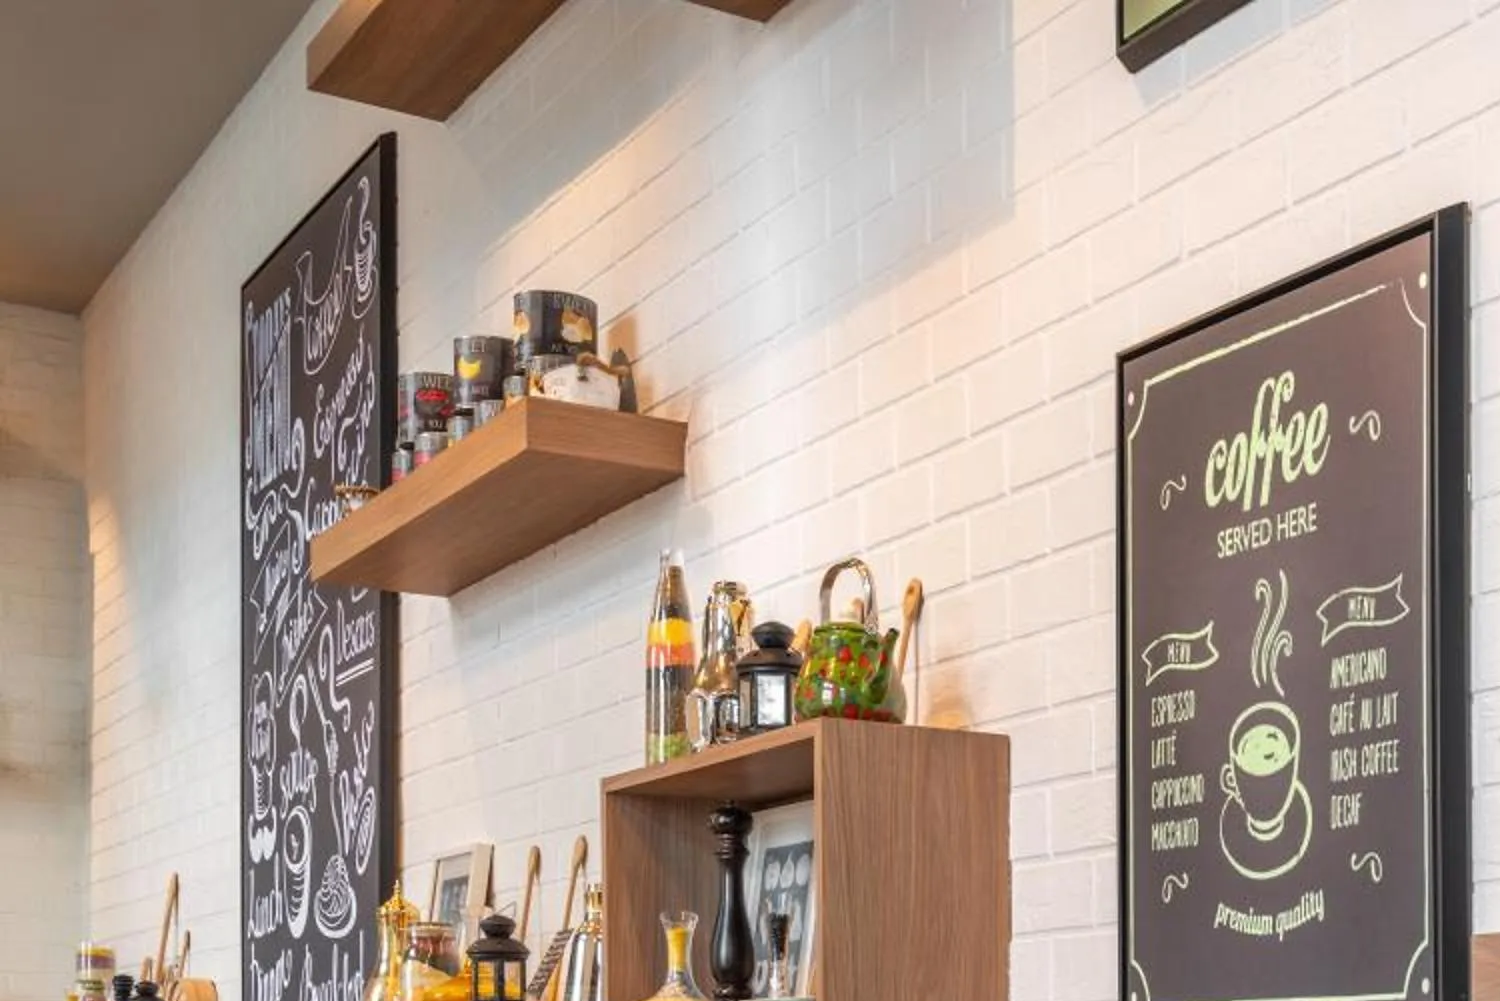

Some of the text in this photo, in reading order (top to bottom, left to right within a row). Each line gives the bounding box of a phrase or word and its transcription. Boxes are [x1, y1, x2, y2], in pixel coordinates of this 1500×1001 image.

[1205, 371, 1330, 511] coffee
[1217, 502, 1317, 558] SERVED HERE
[1330, 647, 1387, 689] AMERICANO
[1151, 690, 1196, 727] ESPRESSO
[1361, 740, 1400, 780] COFFEE
[1330, 793, 1362, 831] DECAF
[1213, 889, 1325, 941] premium quality
